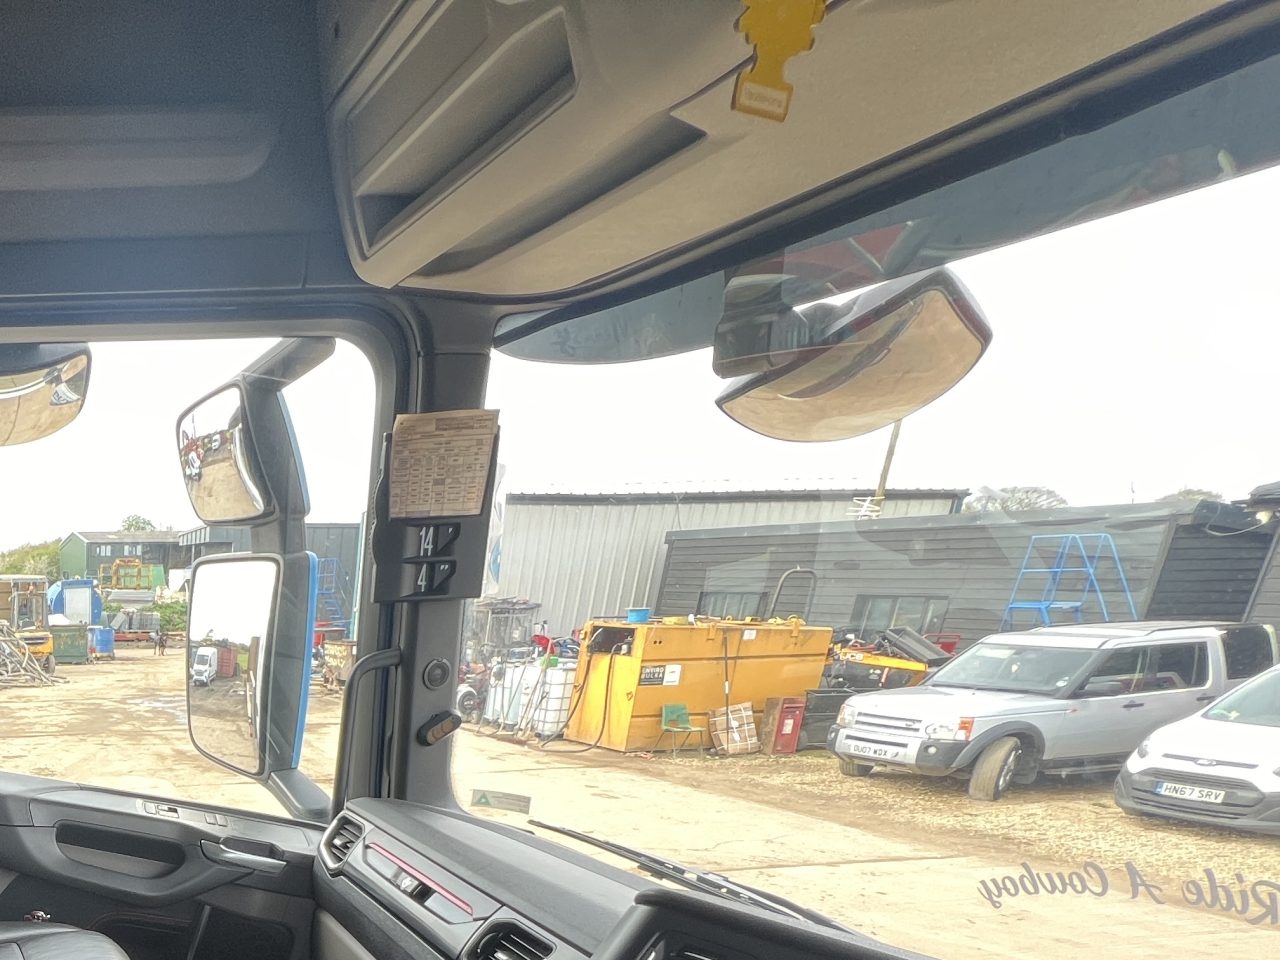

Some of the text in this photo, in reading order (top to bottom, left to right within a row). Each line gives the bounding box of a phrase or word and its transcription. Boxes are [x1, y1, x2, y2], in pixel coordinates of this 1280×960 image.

[419, 526, 434, 557] 14
[417, 563, 427, 593] 4
[841, 652, 864, 661] JCB
[1164, 784, 1222, 801] HN67 SRV
